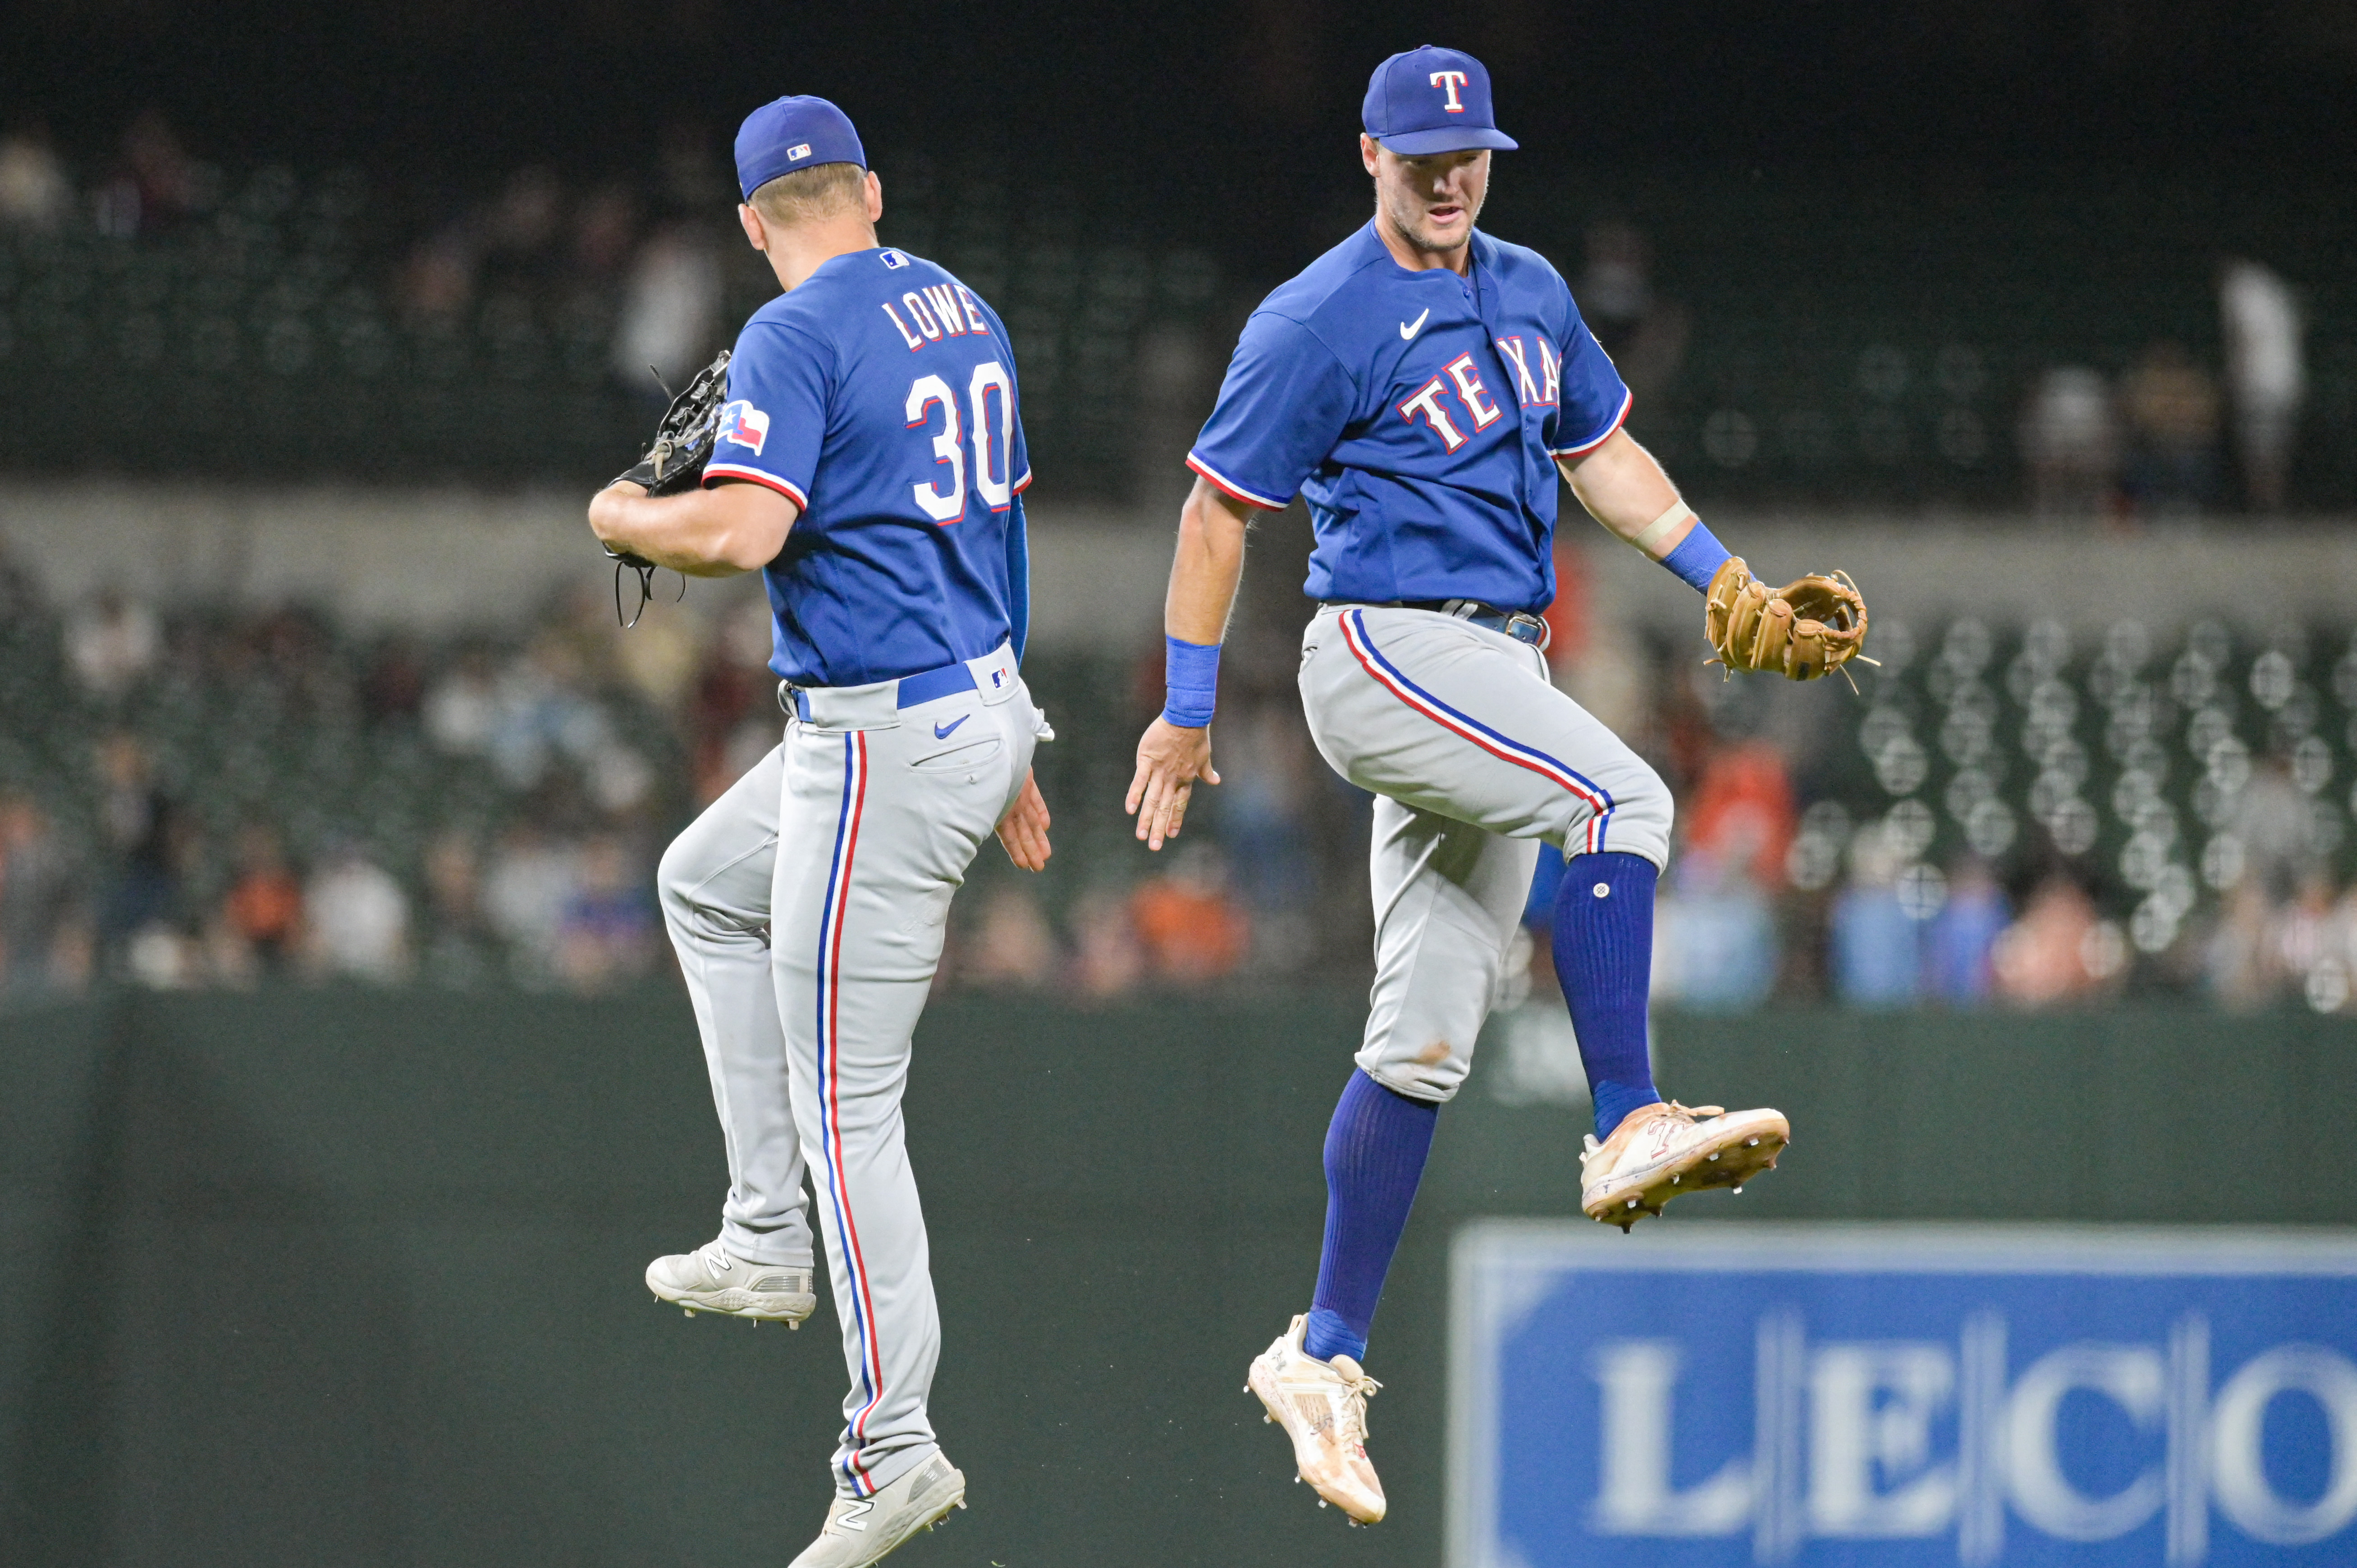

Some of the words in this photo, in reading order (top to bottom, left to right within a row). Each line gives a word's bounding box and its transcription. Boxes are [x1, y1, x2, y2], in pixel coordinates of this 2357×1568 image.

[1429, 70, 1468, 113] T
[882, 283, 989, 352] LOWE
[1396, 336, 1563, 455] TEXA
[904, 361, 1014, 526] 30
